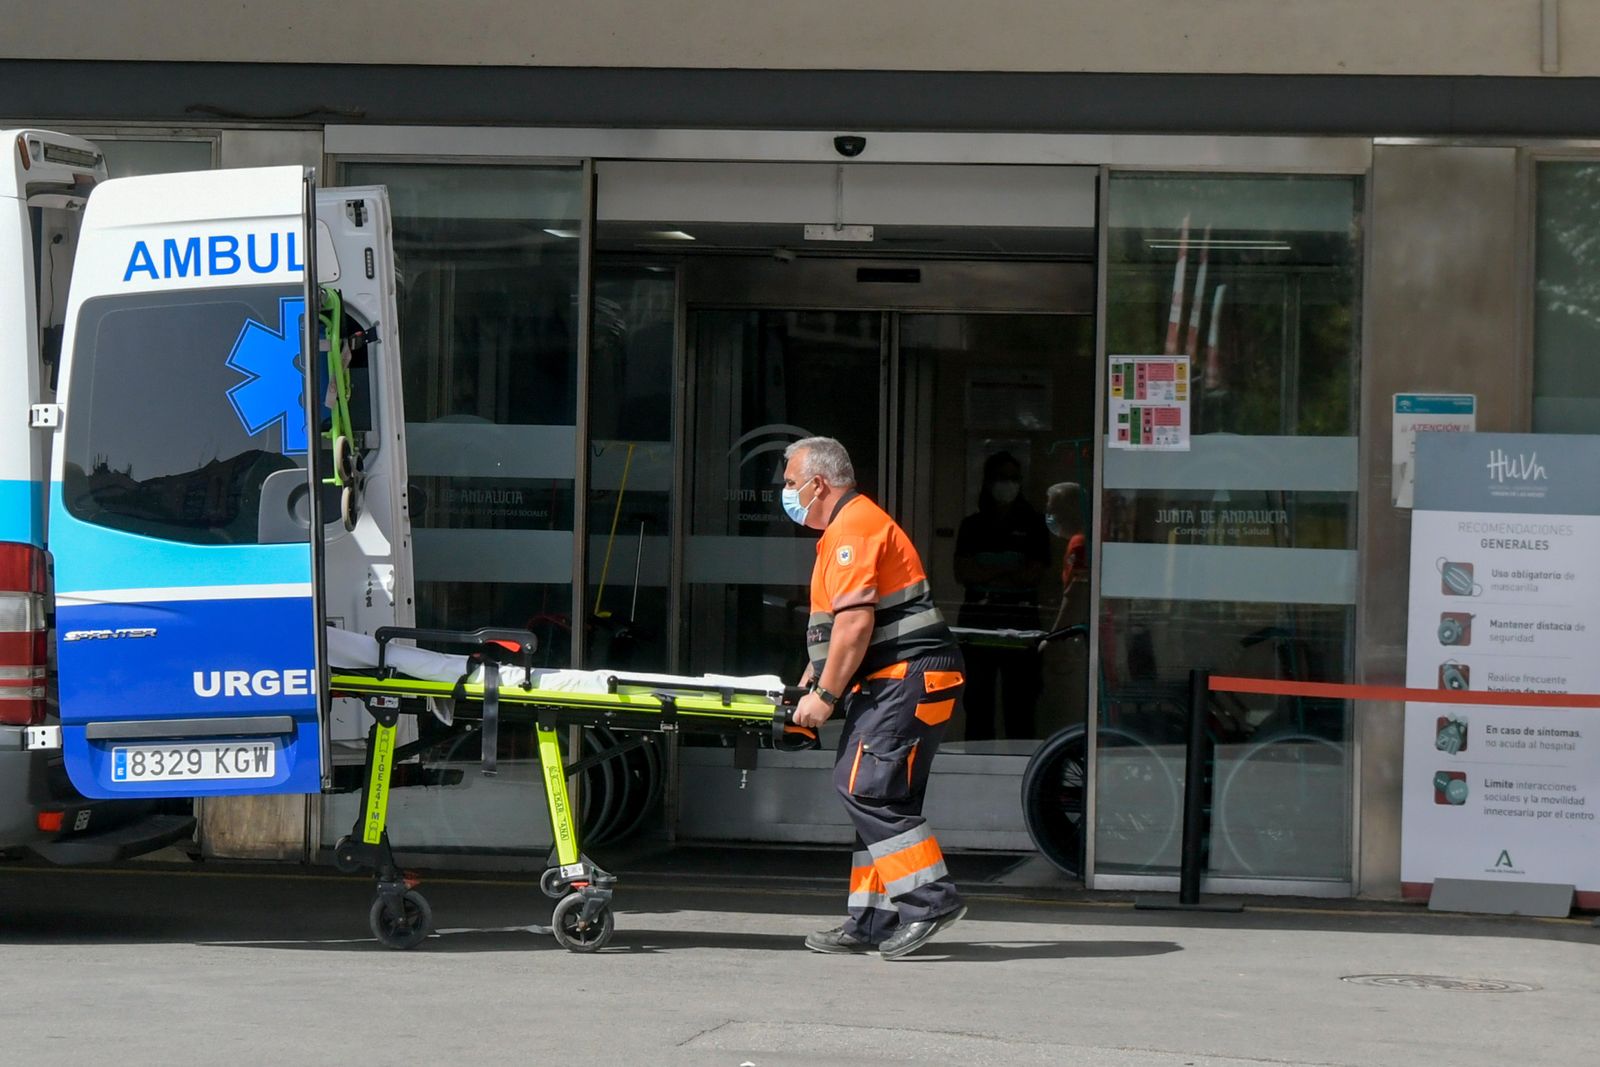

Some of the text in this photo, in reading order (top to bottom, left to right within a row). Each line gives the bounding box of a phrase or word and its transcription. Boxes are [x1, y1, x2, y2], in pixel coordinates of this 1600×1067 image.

[122, 232, 304, 282] AMBUL
[761, 490, 774, 502] DE
[1155, 509, 1194, 524] JUNTA
[1200, 510, 1216, 524] DE
[1227, 527, 1240, 536] de
[1243, 527, 1270, 536] Salud
[1458, 521, 1573, 536] RECOMENDACIONES
[1480, 538, 1549, 551] GENERALES
[1491, 569, 1575, 581] Uso obligatorio de
[1490, 583, 1538, 592] mascarilla
[1489, 619, 1586, 631] Mantener distacia de
[63, 627, 158, 642] SPRINTER
[193, 669, 315, 698] URGE
[1488, 672, 1567, 685] Realice frecuente
[1486, 725, 1498, 734] En
[1500, 727, 1521, 735] caso
[1523, 727, 1535, 736] de
[1485, 740, 1576, 752] no acuda al hospital
[130, 746, 270, 777] 8329 KGW
[116, 767, 125, 776] E
[1484, 779, 1577, 792] Limite interacciones
[1484, 793, 1585, 806] sociales y la movilidad
[1484, 806, 1595, 821] innecesaria por el centro
